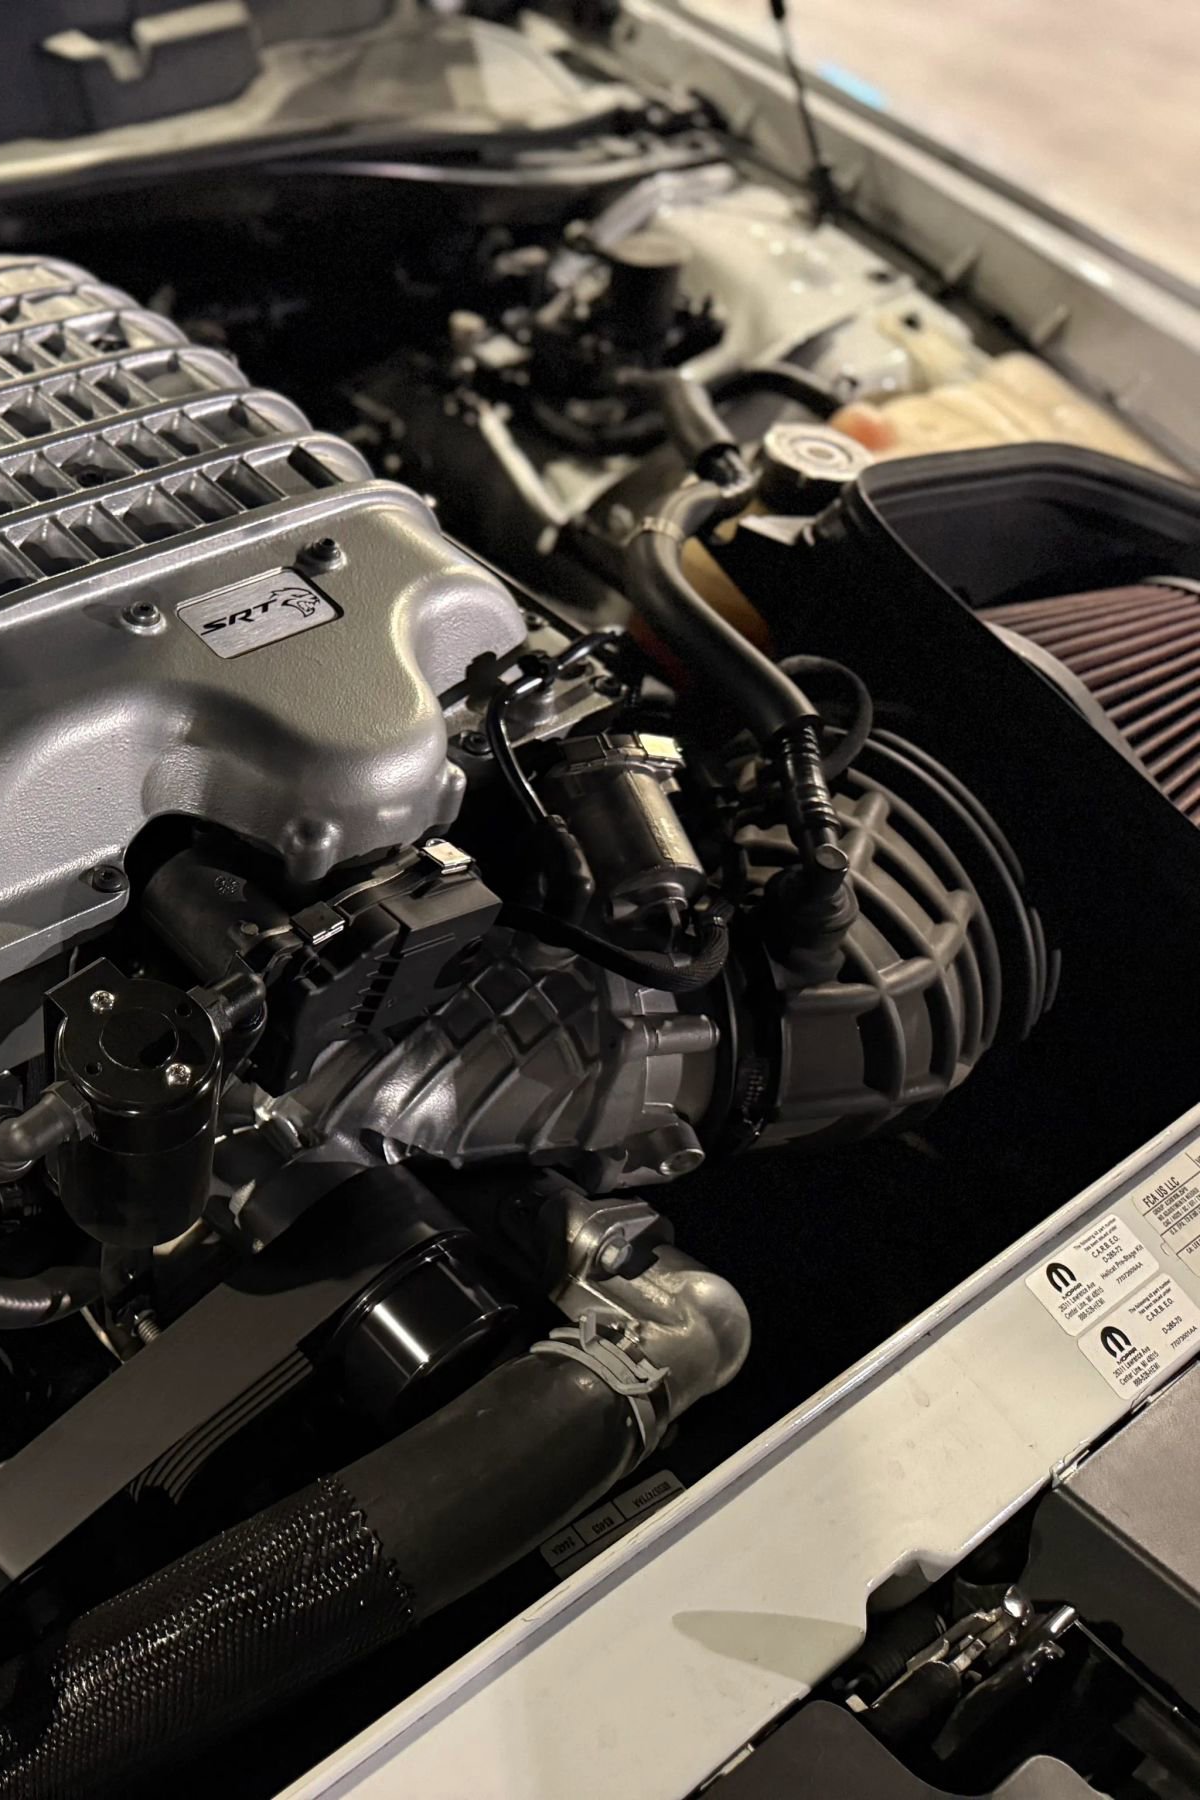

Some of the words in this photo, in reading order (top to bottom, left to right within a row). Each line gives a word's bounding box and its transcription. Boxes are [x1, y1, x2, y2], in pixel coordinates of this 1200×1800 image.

[200, 599, 277, 636] SRT
[1142, 1193, 1159, 1208] FCA
[1154, 1185, 1168, 1198] US
[1164, 1176, 1180, 1191] LLC
[1062, 1282, 1082, 1300] MOPAR
[1116, 1347, 1137, 1365] MOPAR
